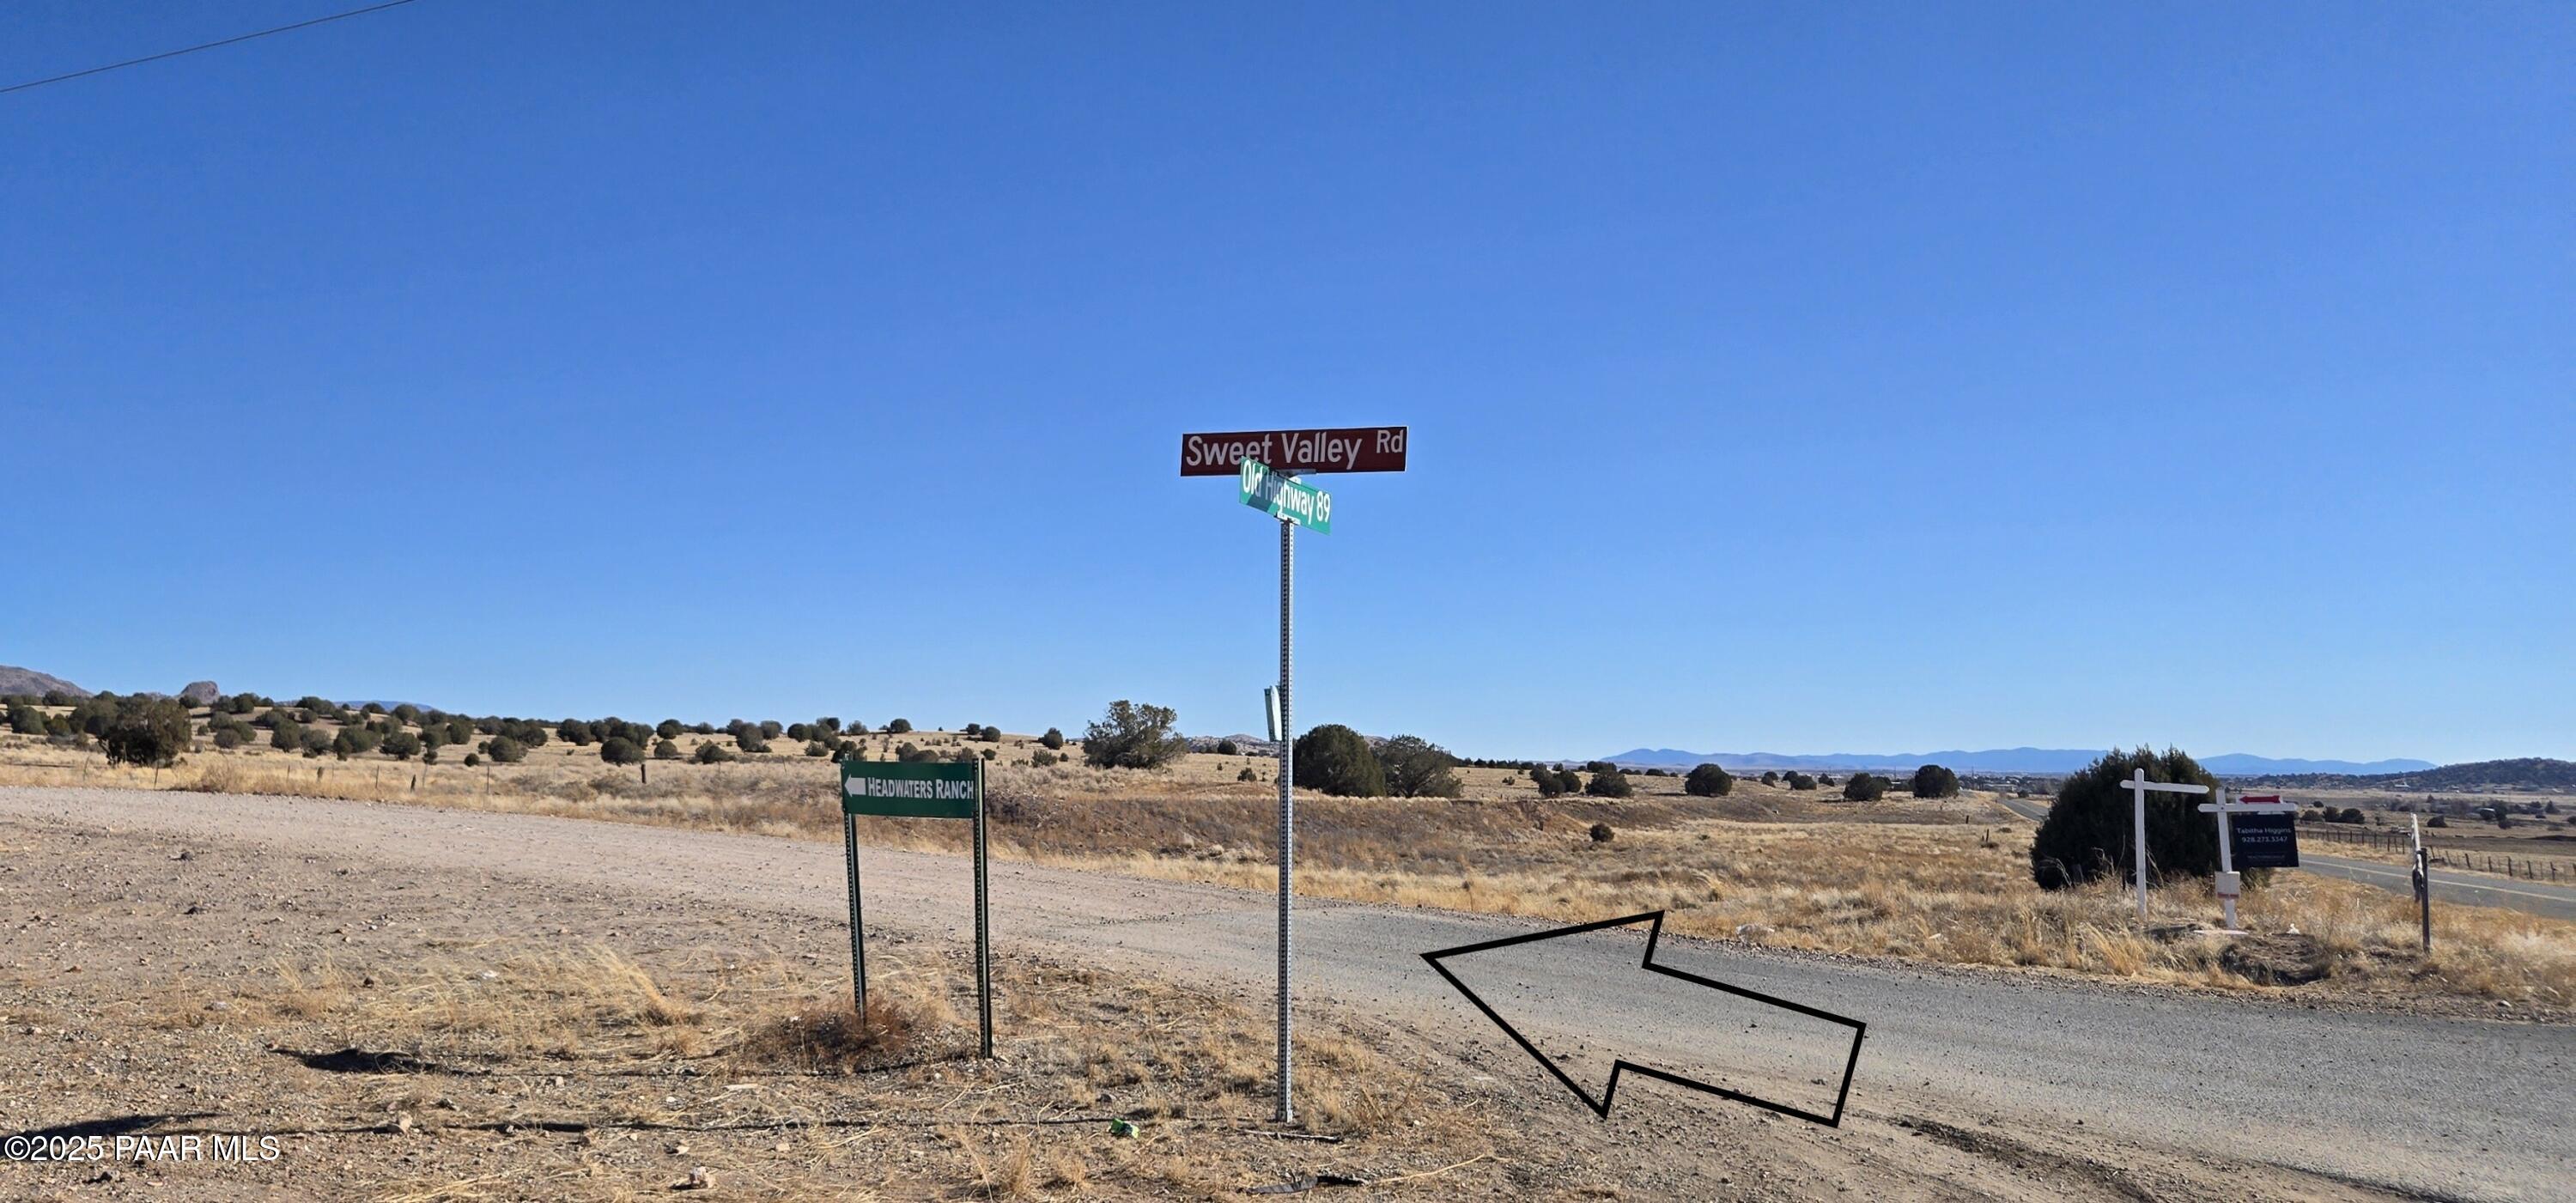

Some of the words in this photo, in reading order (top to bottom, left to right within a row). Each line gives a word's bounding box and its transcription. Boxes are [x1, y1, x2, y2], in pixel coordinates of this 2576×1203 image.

[1186, 434, 1273, 466] Sweet
[1281, 432, 1363, 470] Valley
[1376, 429, 1404, 453] Rd
[1242, 459, 1263, 497] Old
[1265, 470, 1315, 525] Highway
[1316, 490, 1331, 523] 89
[867, 777, 933, 799] HEADWATERS
[936, 779, 975, 799] RANCH
